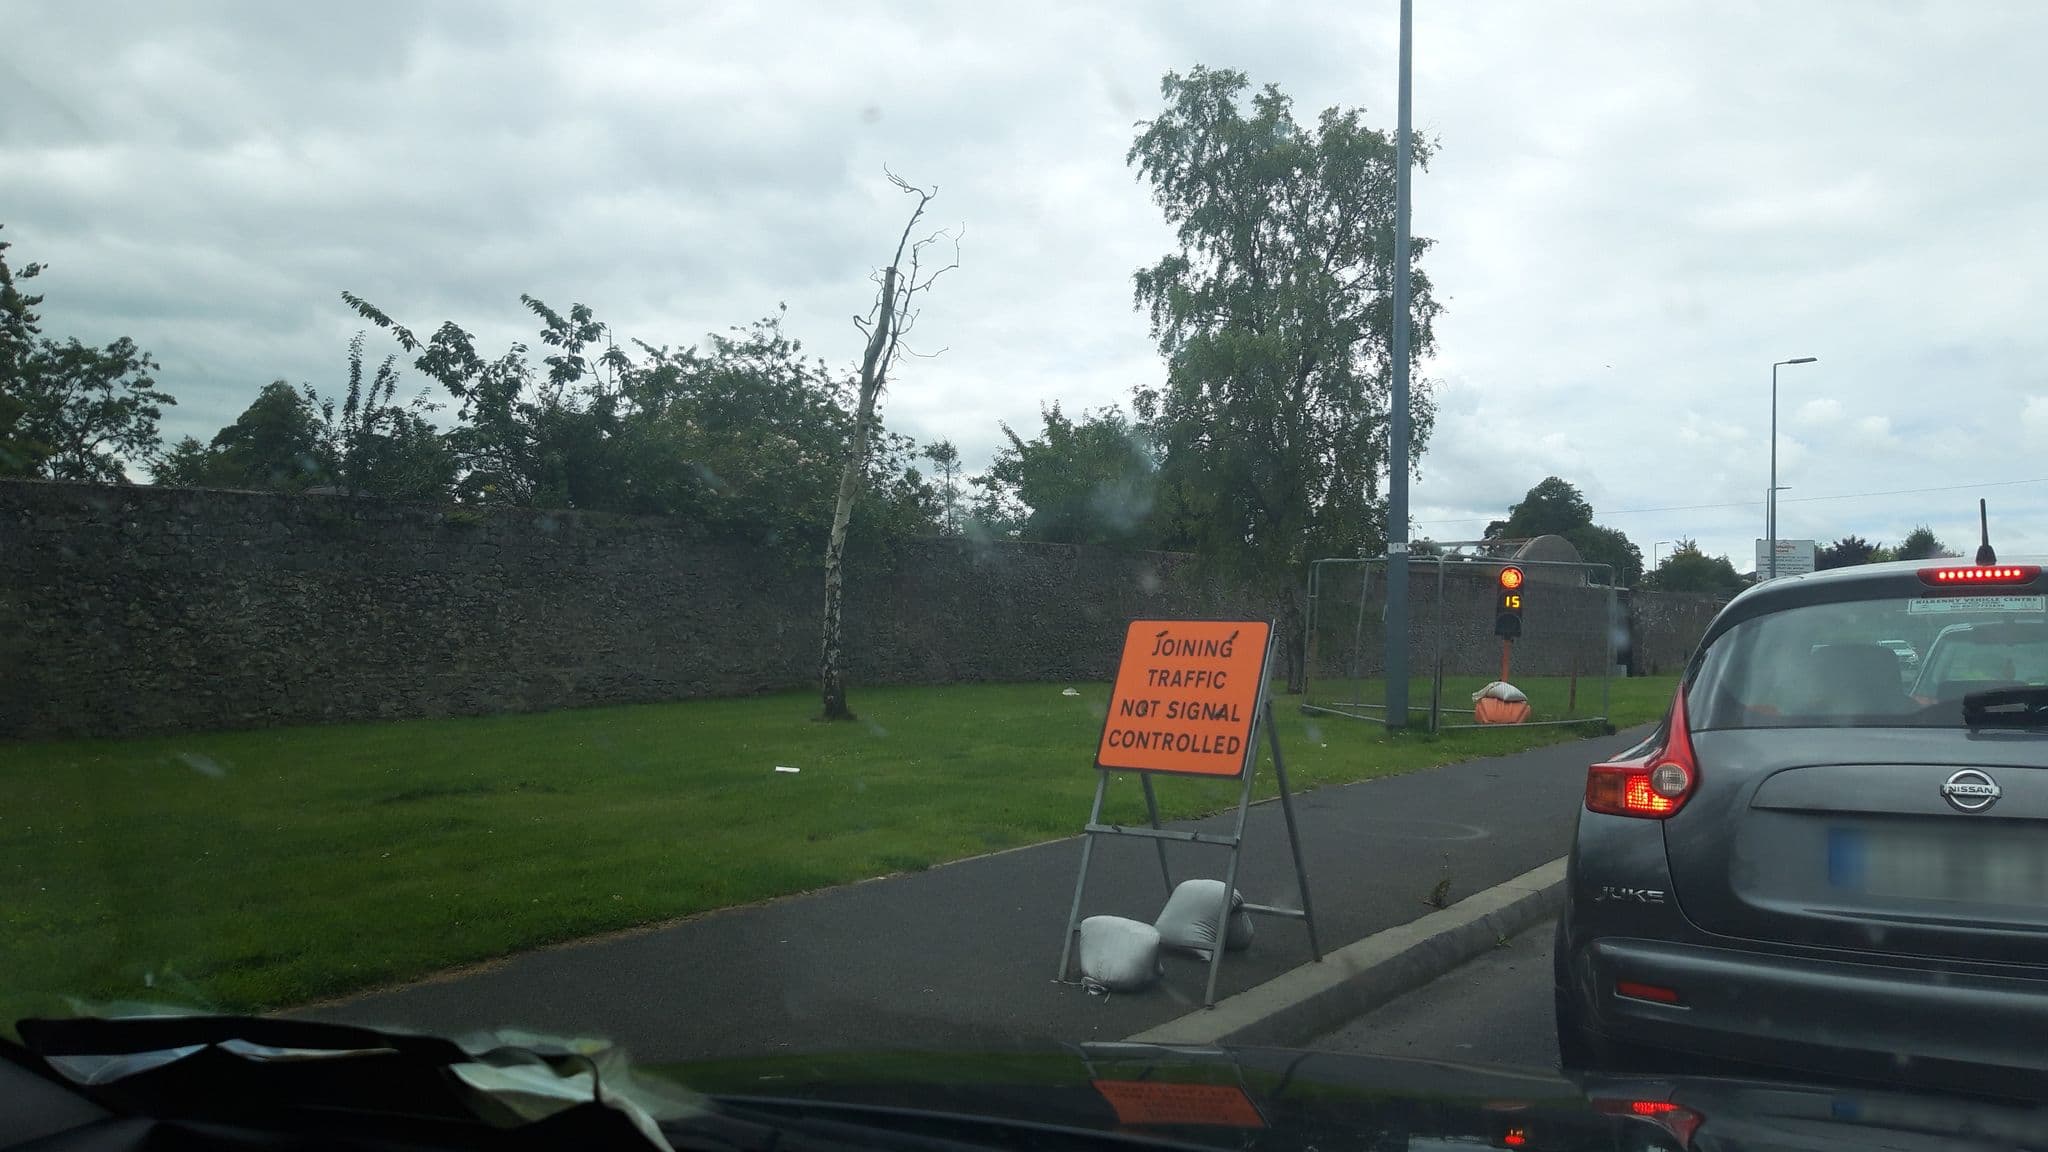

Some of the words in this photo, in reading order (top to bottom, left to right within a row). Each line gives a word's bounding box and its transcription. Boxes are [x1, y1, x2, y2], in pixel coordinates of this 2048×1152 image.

[1506, 595, 1520, 608] 15
[1152, 638, 1233, 658] JOINING
[1148, 668, 1227, 689] TRAFFIC
[1120, 698, 1160, 718] NOT
[1166, 700, 1241, 722] SIGNAL
[1108, 729, 1240, 755] CONTROLLED
[1949, 785, 1993, 794] NISSAN
[1594, 886, 1665, 904] JUKE
